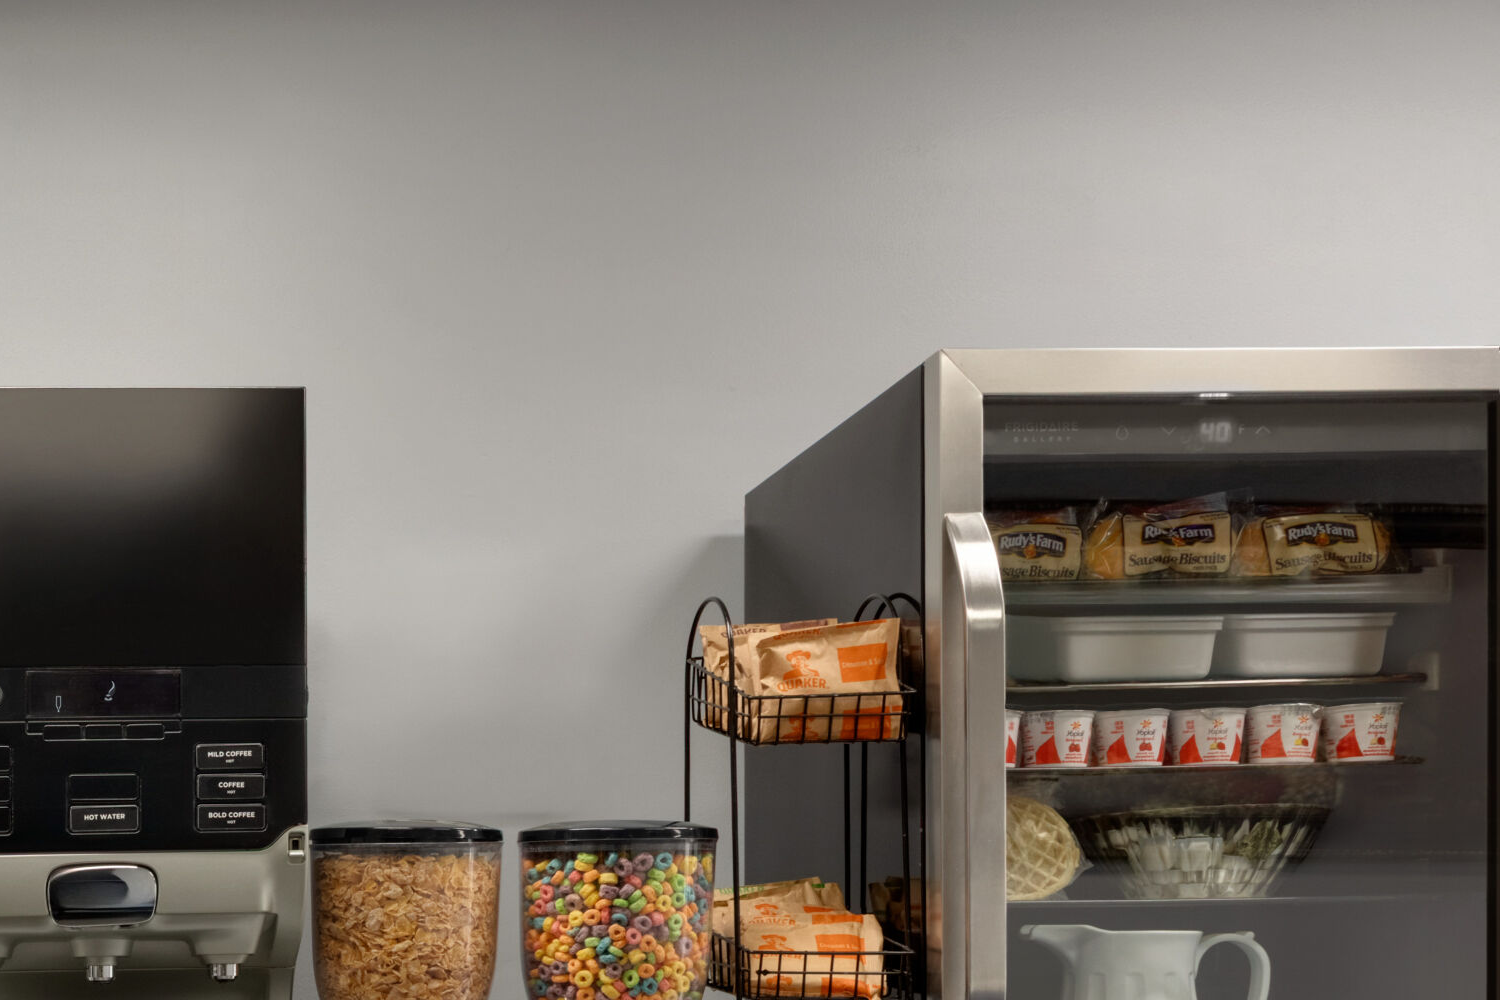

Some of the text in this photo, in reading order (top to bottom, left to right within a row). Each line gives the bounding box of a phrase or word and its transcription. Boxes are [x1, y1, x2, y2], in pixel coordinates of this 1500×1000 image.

[1004, 422, 1080, 432] FRIGIDAIRE
[1200, 421, 1232, 442] 40
[1179, 527, 1213, 539] Farm
[1288, 523, 1326, 541] Rudy's
[1325, 523, 1355, 538] Farm
[1000, 533, 1064, 552] Rudy's Farm
[1029, 565, 1074, 578] Biscuits
[777, 677, 827, 692] QUAKER
[218, 781, 245, 789] COFFEE
